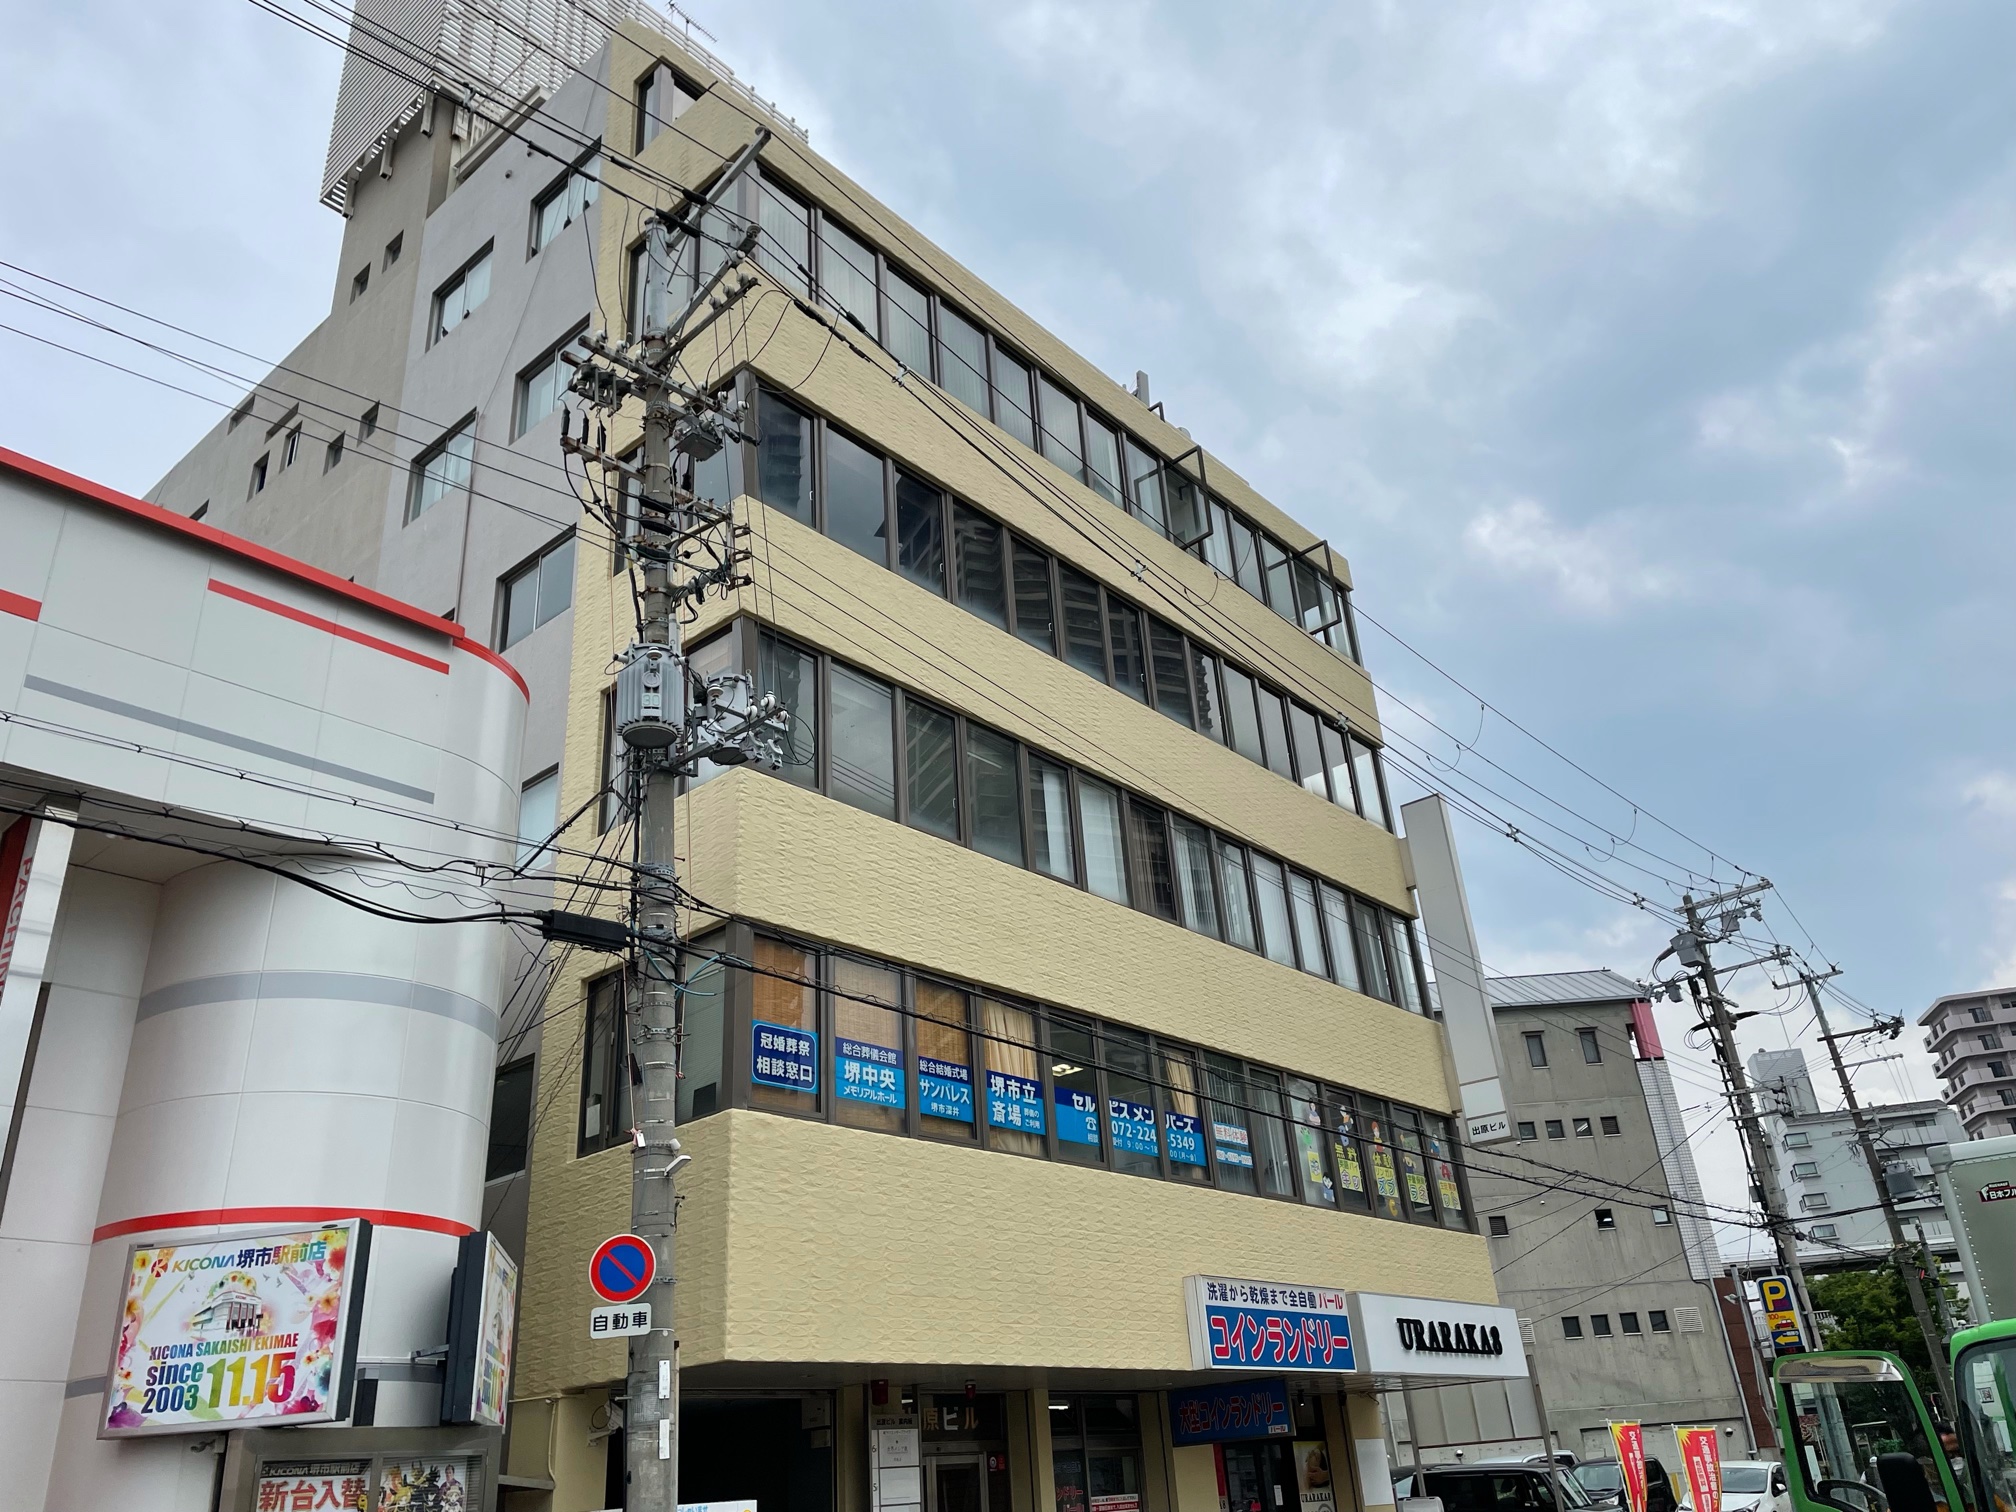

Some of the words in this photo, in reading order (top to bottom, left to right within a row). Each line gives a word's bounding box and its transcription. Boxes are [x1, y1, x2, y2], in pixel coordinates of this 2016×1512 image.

[760, 1033, 810, 1057] 冠婚葬祭
[843, 1043, 897, 1065] 総合葬儀会館
[757, 1056, 813, 1083] 相談窓口
[844, 1061, 896, 1091] 堺中央
[919, 1059, 968, 1081] 総合結婚式場
[844, 1086, 897, 1104] メモリアルホール
[920, 1079, 970, 1105] サンパレス
[991, 1075, 1037, 1105] 堺市立
[992, 1102, 1022, 1126] 斎場
[1472, 1121, 1506, 1136] 出原ビル
[172, 1255, 235, 1273] KICONA
[236, 1240, 327, 1269] 堺市駅前店
[1319, 1292, 1344, 1313] パール
[1763, 1281, 1786, 1311] P
[593, 1311, 648, 1332] 自動車
[149, 1344, 194, 1361] KICONA
[195, 1337, 253, 1357] SAKAISHI
[254, 1332, 299, 1351] EKIMAE
[1211, 1309, 1349, 1365] コインランドリー
[1396, 1317, 1503, 1356] URARAKA8
[141, 1384, 199, 1414] 2003
[912, 1406, 979, 1431] 原ビル
[1179, 1391, 1284, 1435] 大型コインランドリー
